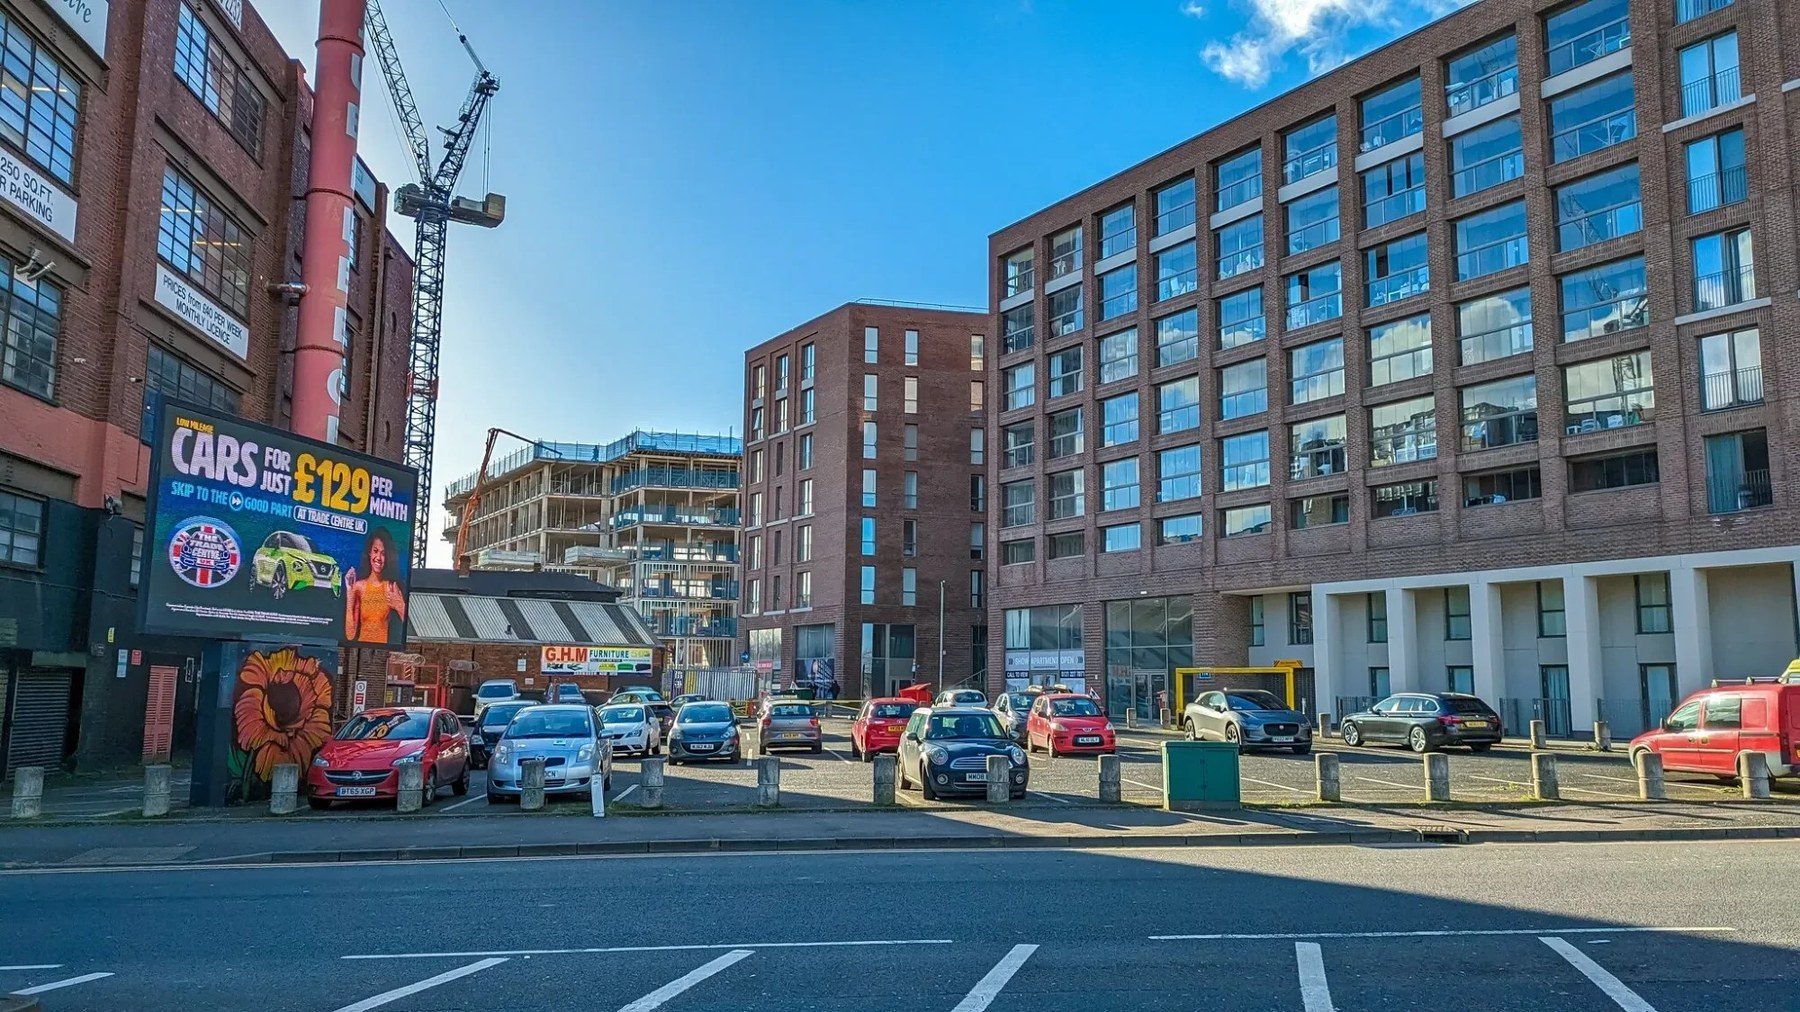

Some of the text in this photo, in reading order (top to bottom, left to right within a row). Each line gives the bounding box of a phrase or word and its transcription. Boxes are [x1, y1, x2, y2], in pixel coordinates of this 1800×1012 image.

[1, 156, 53, 205] 250 SQ.FT.
[10, 182, 53, 222] PARKING
[163, 274, 187, 299] PRICES
[188, 293, 201, 309] from
[214, 311, 225, 328] PER
[226, 320, 243, 340] WEEK
[176, 299, 230, 345] MONTHLY LICENCE
[176, 417, 214, 435] LOW MILEAGE
[171, 427, 291, 488] CARS FOR
[260, 453, 393, 514] JUST £129 PER
[171, 481, 292, 517] SKIP TO THE GOOD PART
[369, 496, 408, 522] MONTH
[297, 507, 364, 532] AT TRADE CENTRE UK
[189, 540, 224, 551] TRADE
[198, 533, 218, 542] THE
[192, 547, 221, 560] CENTRE
[545, 647, 588, 663] G.H.M
[589, 649, 629, 658] FURNITURE
[1015, 656, 1074, 665] SHOW APARTMENT OPEN
[360, 787, 375, 795] XGP
